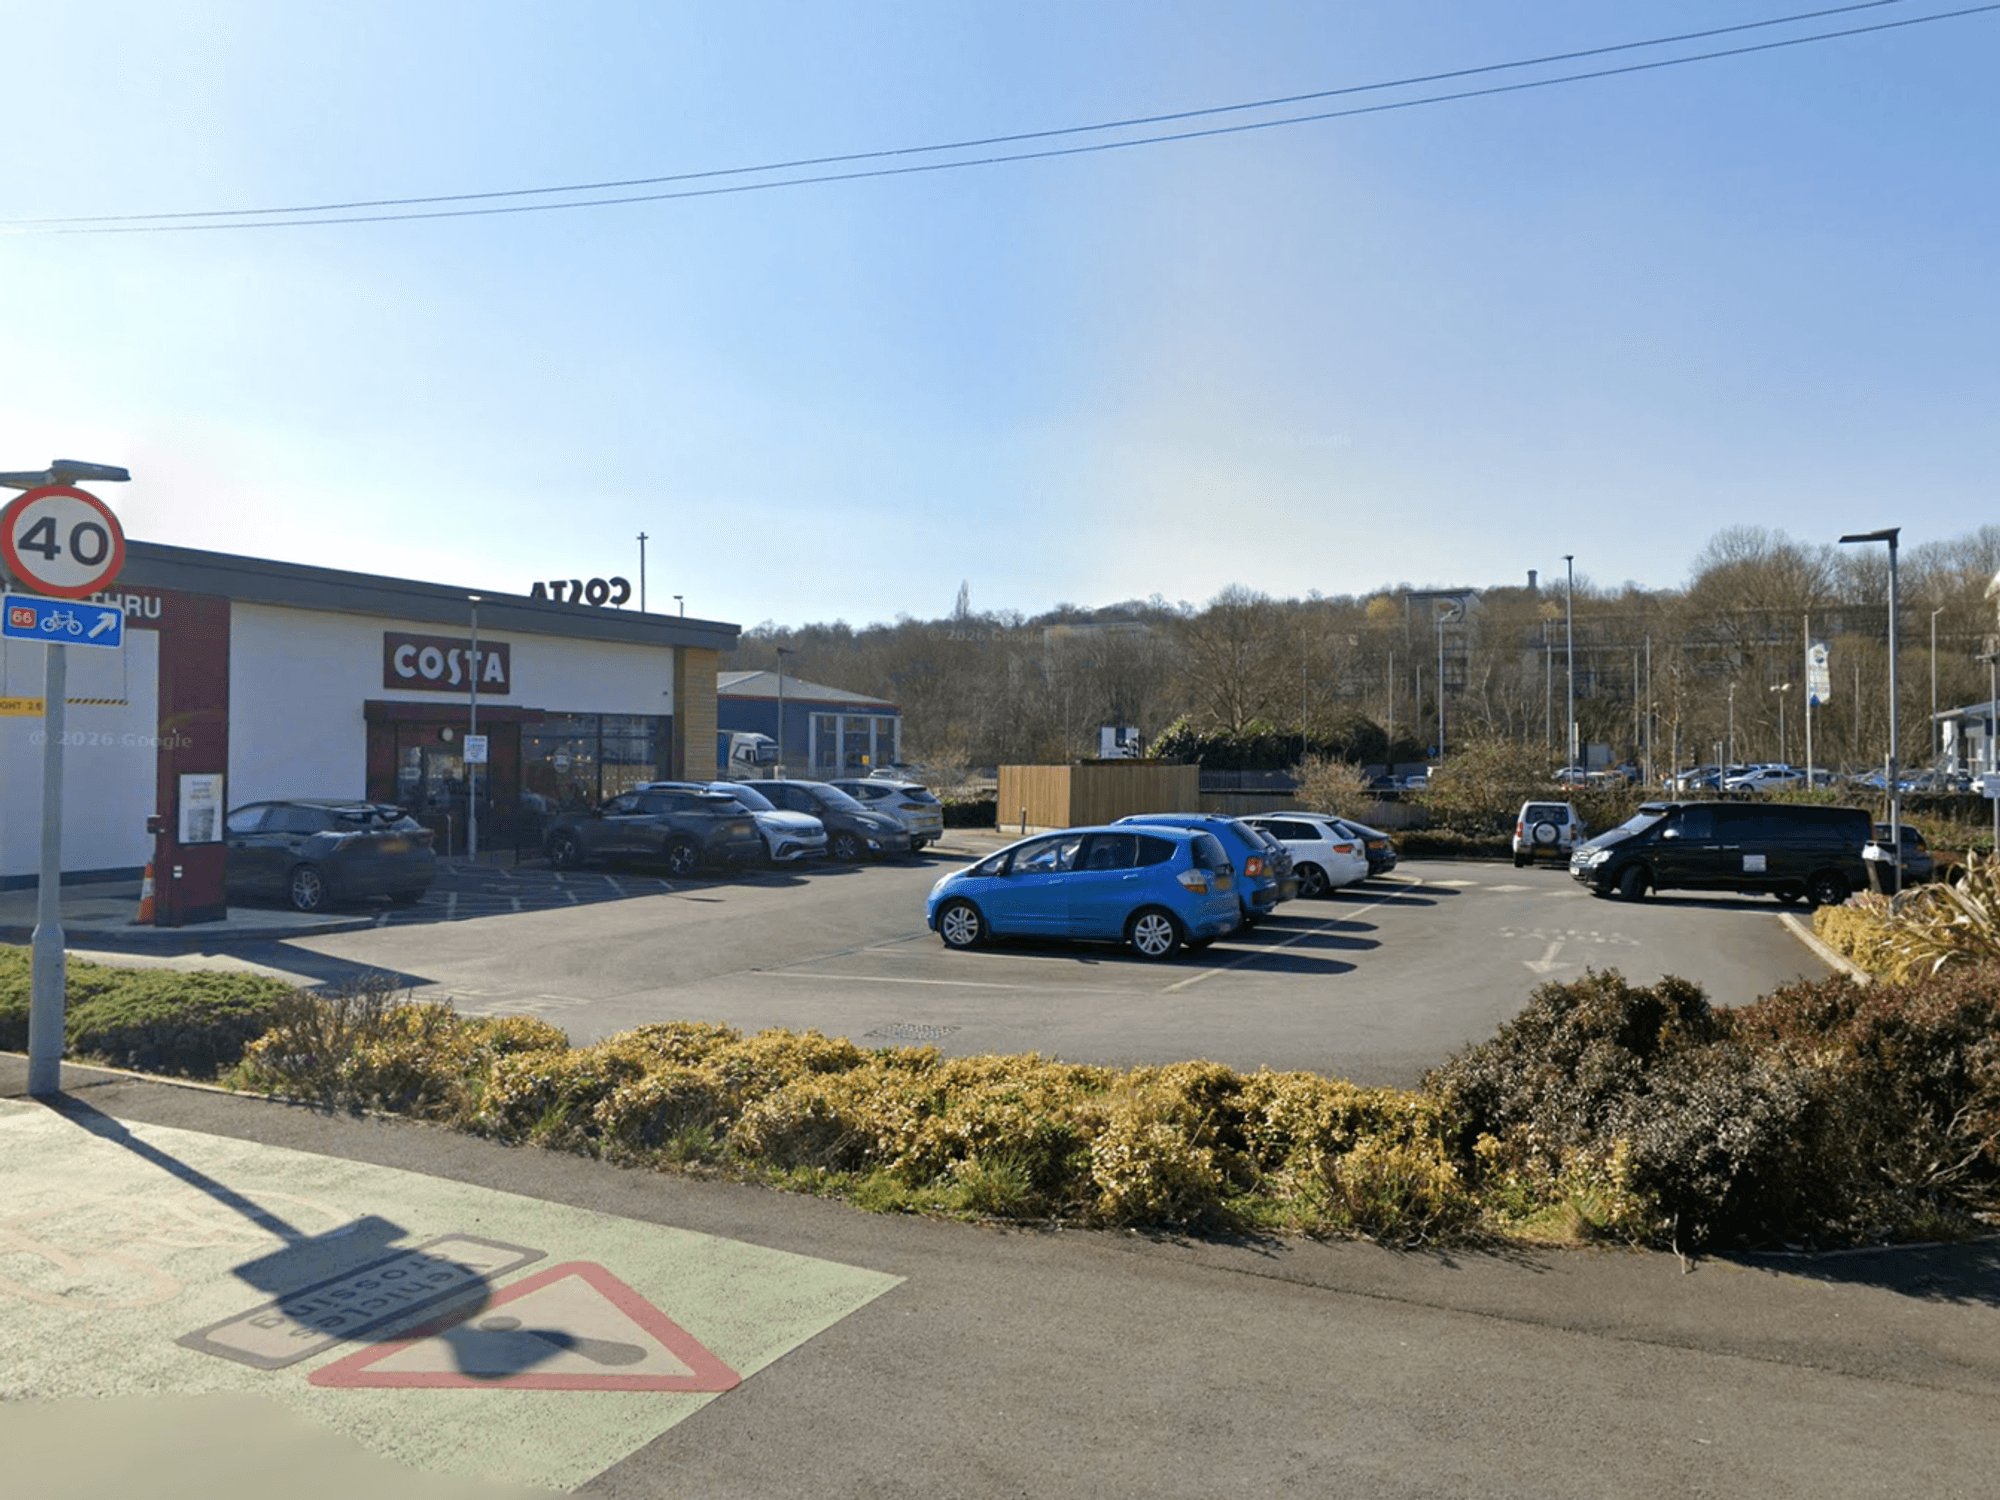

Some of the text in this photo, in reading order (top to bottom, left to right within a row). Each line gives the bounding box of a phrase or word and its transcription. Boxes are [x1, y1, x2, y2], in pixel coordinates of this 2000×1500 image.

[17, 516, 110, 567] 40
[394, 643, 506, 686] COSTA
[248, 1252, 449, 1330] crossing
[289, 1262, 493, 1340] Vehicles
